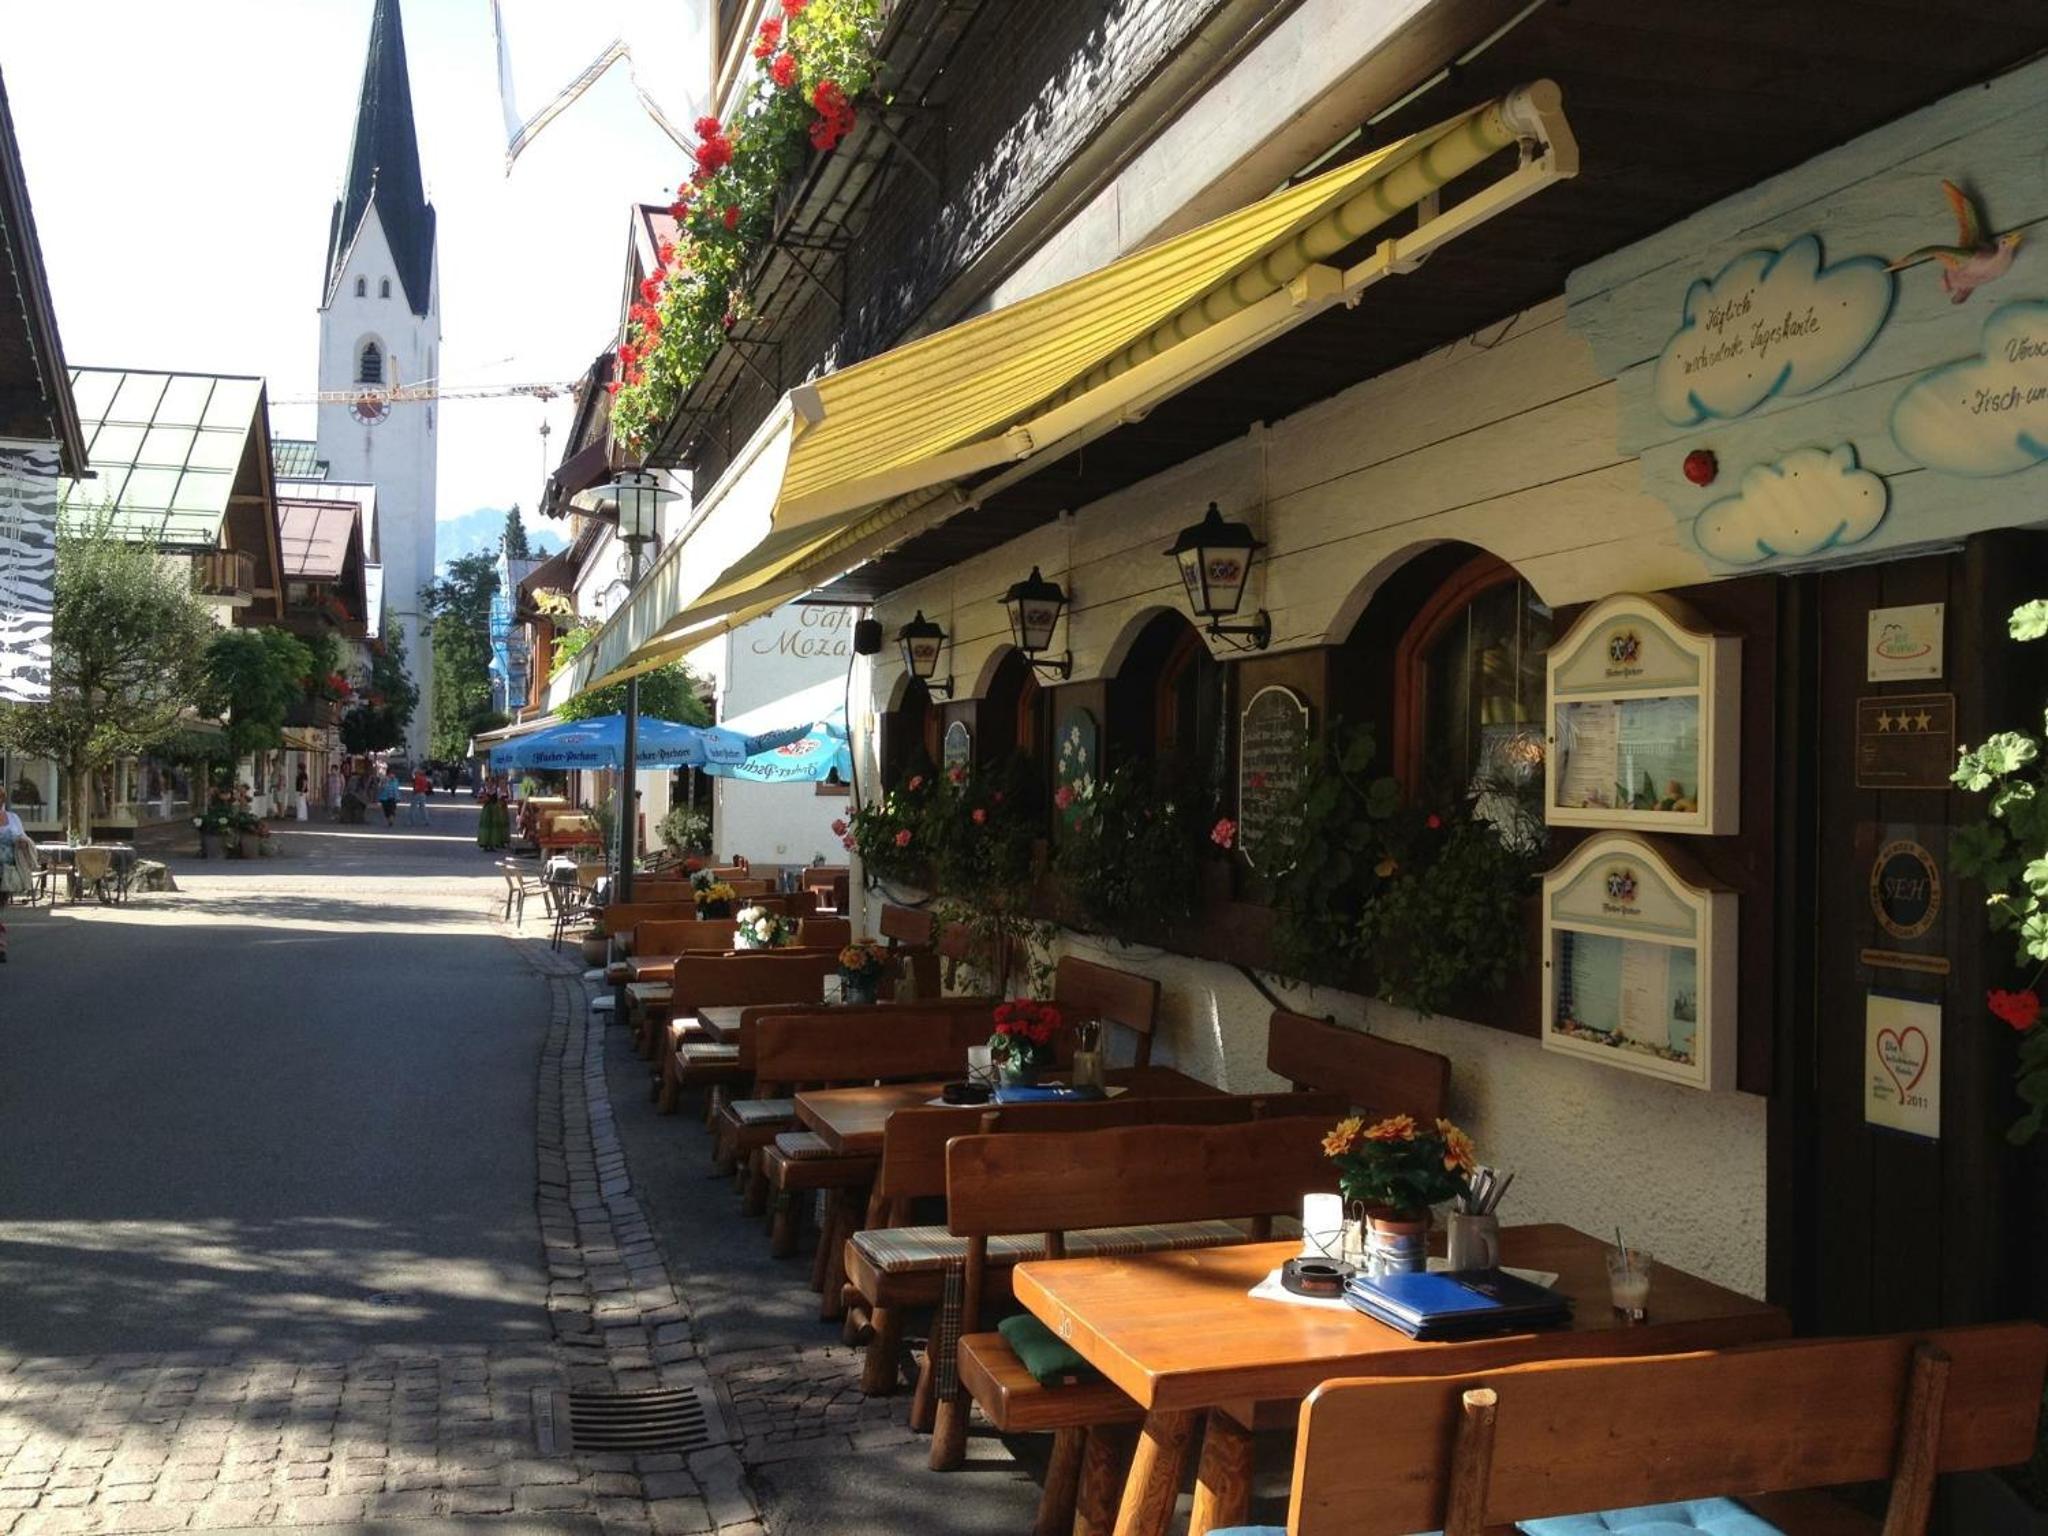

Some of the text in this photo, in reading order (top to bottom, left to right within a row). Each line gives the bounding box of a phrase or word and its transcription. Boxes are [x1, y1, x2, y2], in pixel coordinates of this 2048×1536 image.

[1750, 306, 1821, 360] Tageskarte
[751, 629, 852, 660] Moza
[1906, 1095, 1928, 1109] 2011
